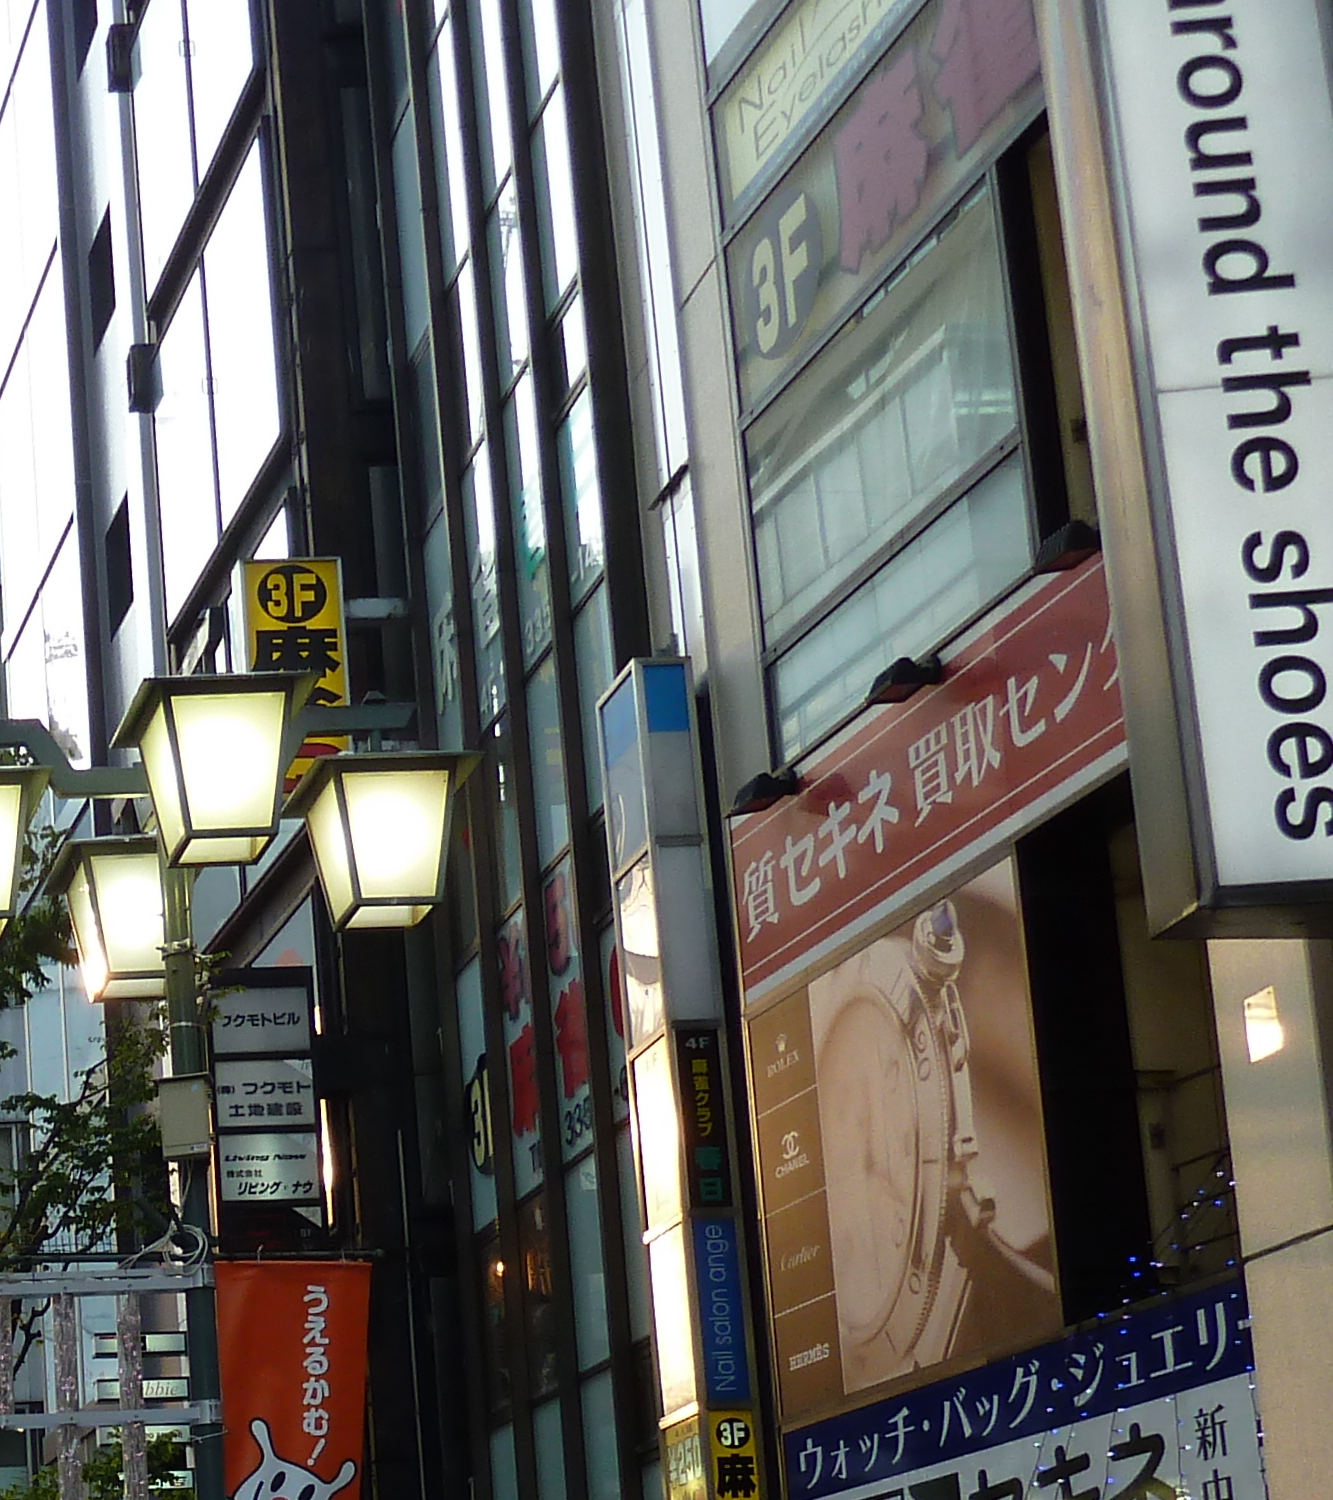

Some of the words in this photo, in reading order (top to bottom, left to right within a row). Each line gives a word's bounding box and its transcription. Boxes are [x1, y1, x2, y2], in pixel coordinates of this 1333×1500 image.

[1165, 0, 1296, 297] round
[750, 191, 811, 355] 3F
[1214, 324, 1314, 494] the
[265, 573, 319, 616] 3F
[1240, 529, 1333, 842] shoes
[741, 769, 900, 944] 質セキネ
[684, 1036, 710, 1050] 4F
[765, 1051, 801, 1079] ROLEX
[241, 1080, 312, 1095] フクモト
[691, 1057, 714, 1138] 麻雀クラブ
[228, 1102, 304, 1118] 土地建設
[774, 1153, 811, 1181] CHANEL
[705, 1224, 729, 1282] ange
[779, 1242, 823, 1273] Cartier
[709, 1288, 732, 1345] salon
[712, 1351, 737, 1391] Nail
[719, 1421, 746, 1447] 3F
